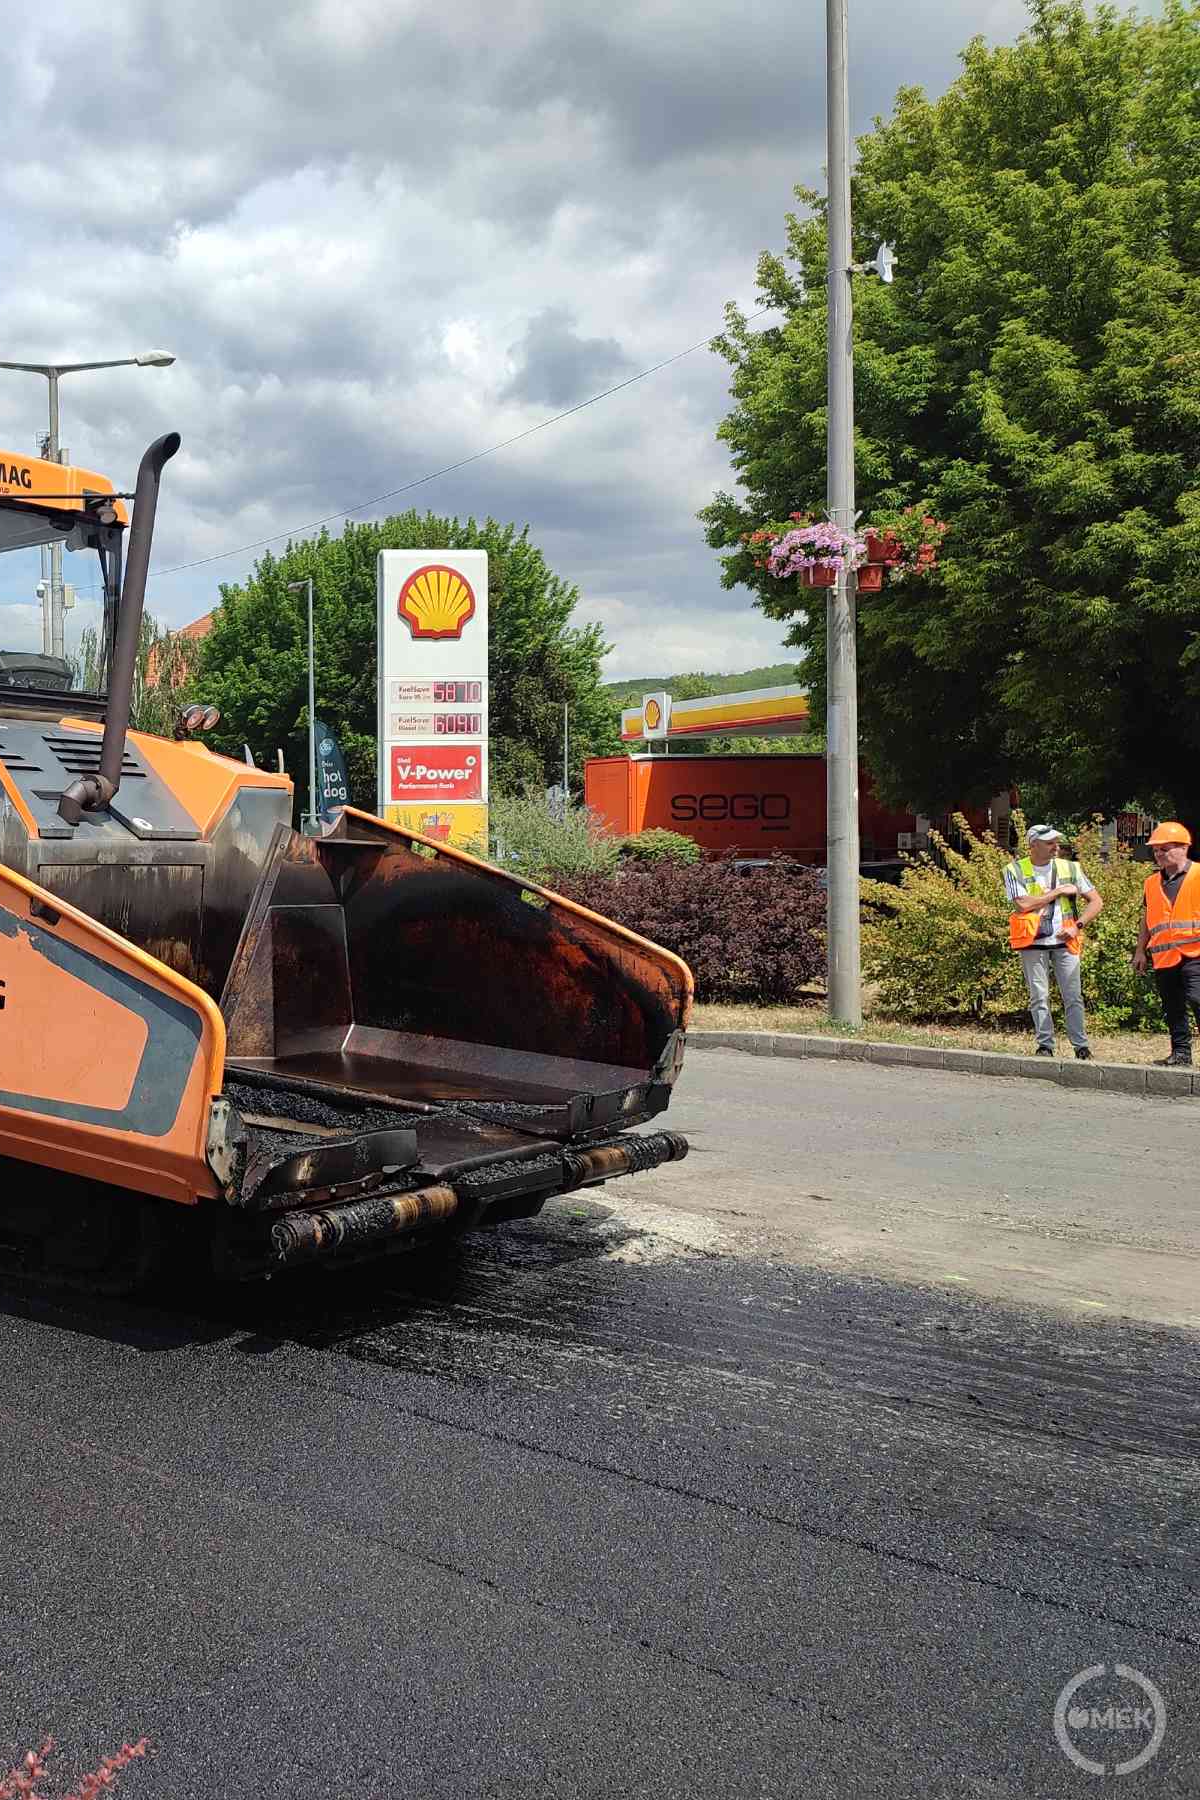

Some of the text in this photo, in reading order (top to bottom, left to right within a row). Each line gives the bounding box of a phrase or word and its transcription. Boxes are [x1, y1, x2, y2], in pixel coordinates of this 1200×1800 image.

[323, 767, 342, 783] hot
[397, 764, 472, 780] V-Power
[324, 783, 347, 800] dog
